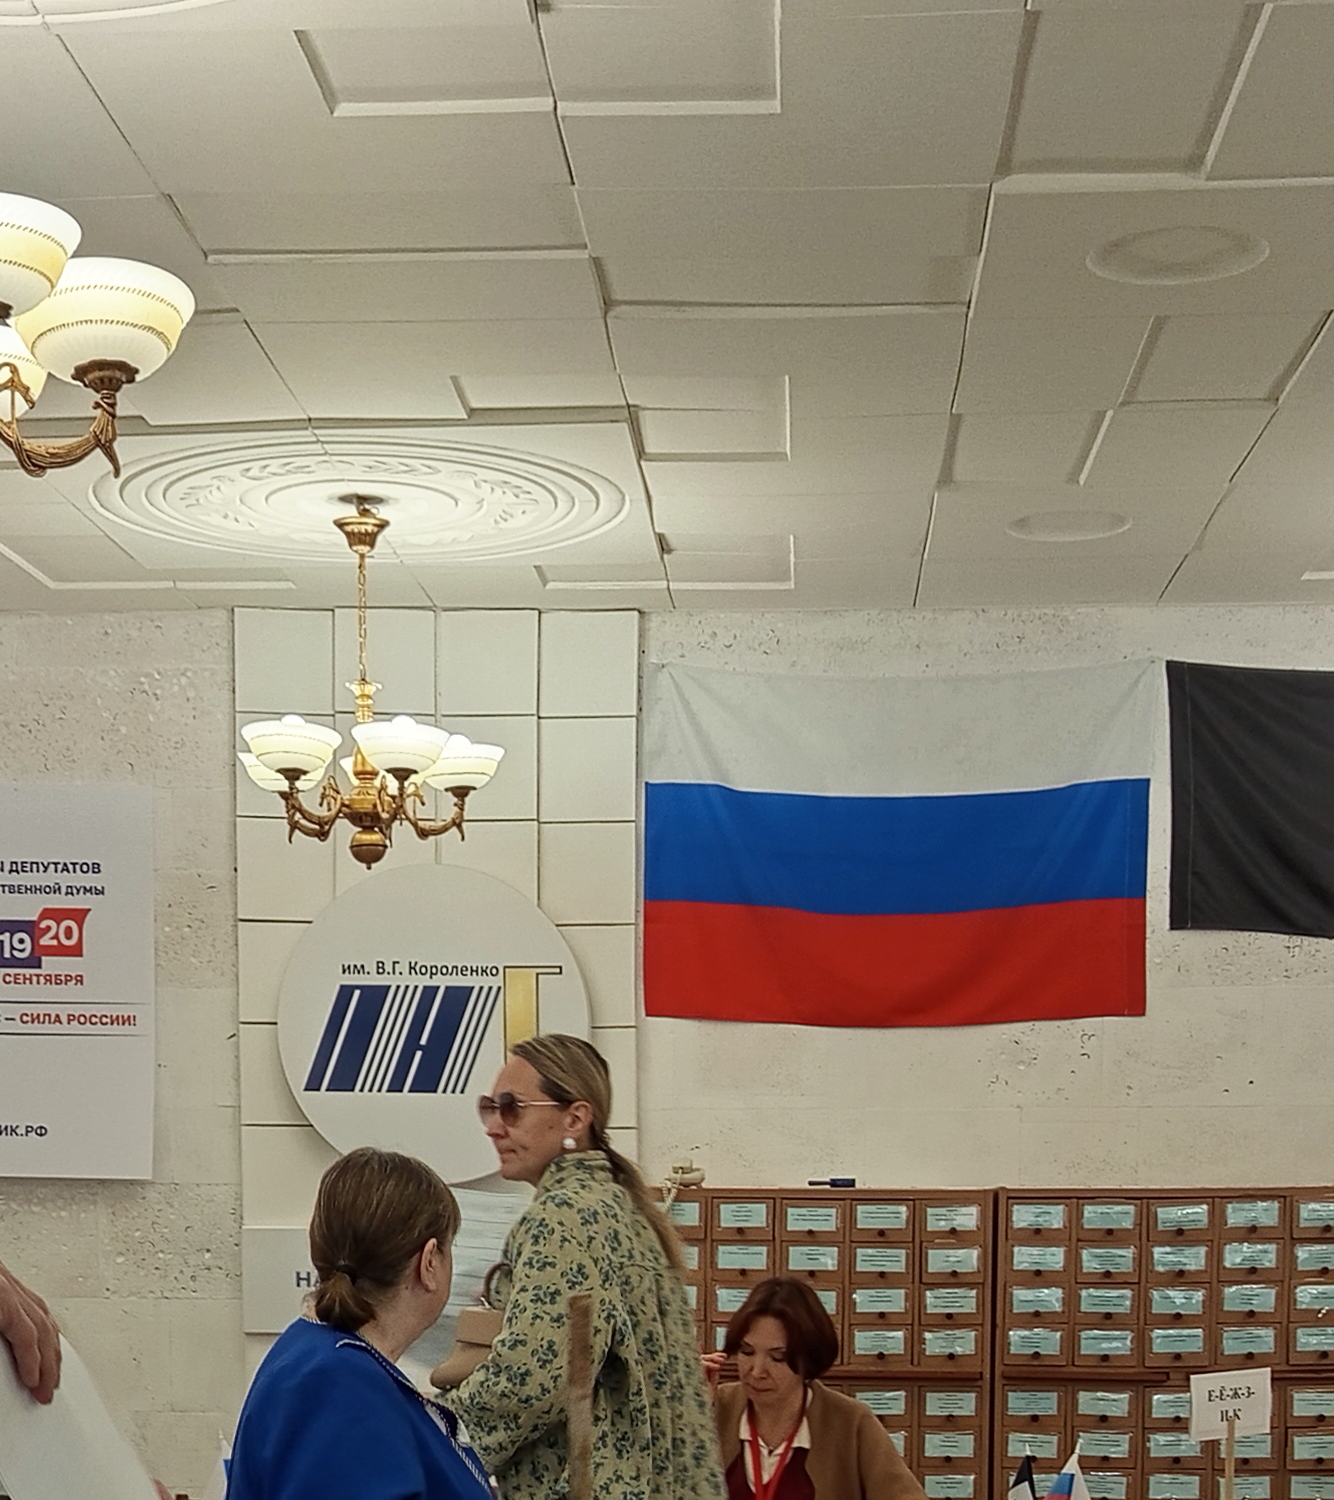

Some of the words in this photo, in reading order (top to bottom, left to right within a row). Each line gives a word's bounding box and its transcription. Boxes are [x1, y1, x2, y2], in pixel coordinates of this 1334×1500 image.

[8, 861, 101, 875] ДЕПУТАТОВ
[64, 885, 105, 897] ДУМЫ
[39, 919, 80, 946] 20
[341, 963, 370, 975] им.
[376, 961, 403, 975] В.Г.
[408, 961, 499, 979] Короленко
[2, 973, 84, 986] СЕНТЯБРЯ
[20, 1013, 63, 1025] СИЛА
[67, 1013, 137, 1026] РОССИИ!
